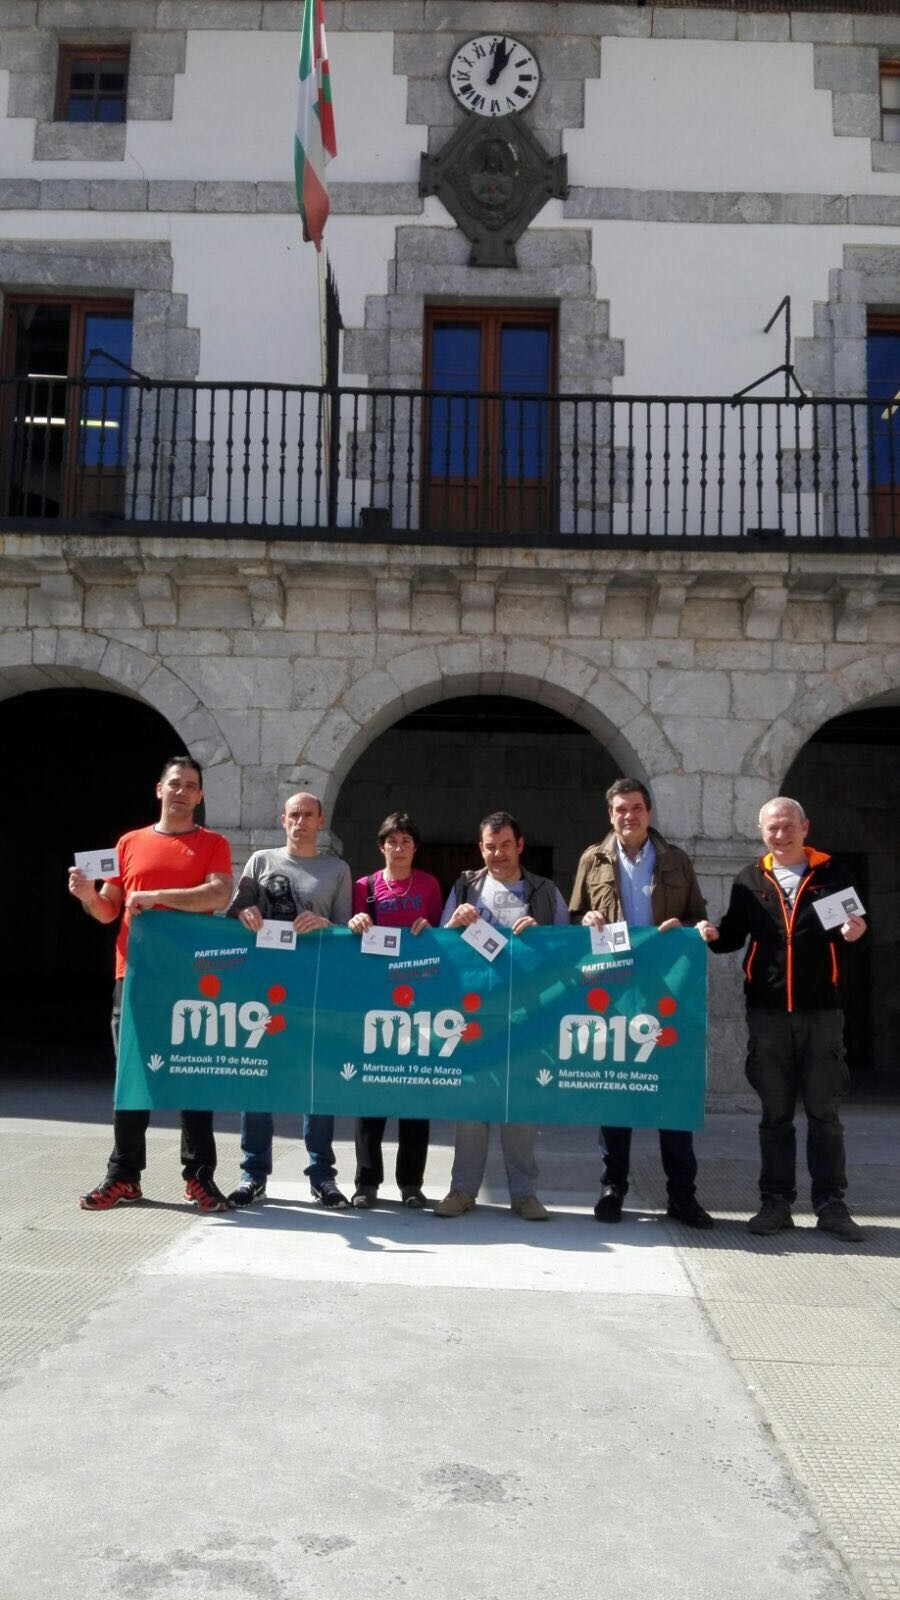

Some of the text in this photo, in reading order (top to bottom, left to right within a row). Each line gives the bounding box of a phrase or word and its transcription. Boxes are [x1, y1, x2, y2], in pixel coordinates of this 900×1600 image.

[194, 947, 248, 958] PARTE HARTU!
[388, 957, 440, 970] PARTE HARTU!
[581, 962, 605, 973] PARTE
[170, 1054, 268, 1066] Martxoak 19 de Marzo
[169, 1065, 268, 1077] ERABAKITZERA GOAZ!
[363, 1063, 462, 1075] Martxoak 19 de Marzo
[559, 1069, 659, 1081] Martxoak 19 de Marzo
[362, 1075, 461, 1086] ERABAKITZERA GOAZ!
[558, 1080, 658, 1092] ERABAKITZERA GOAZ!
